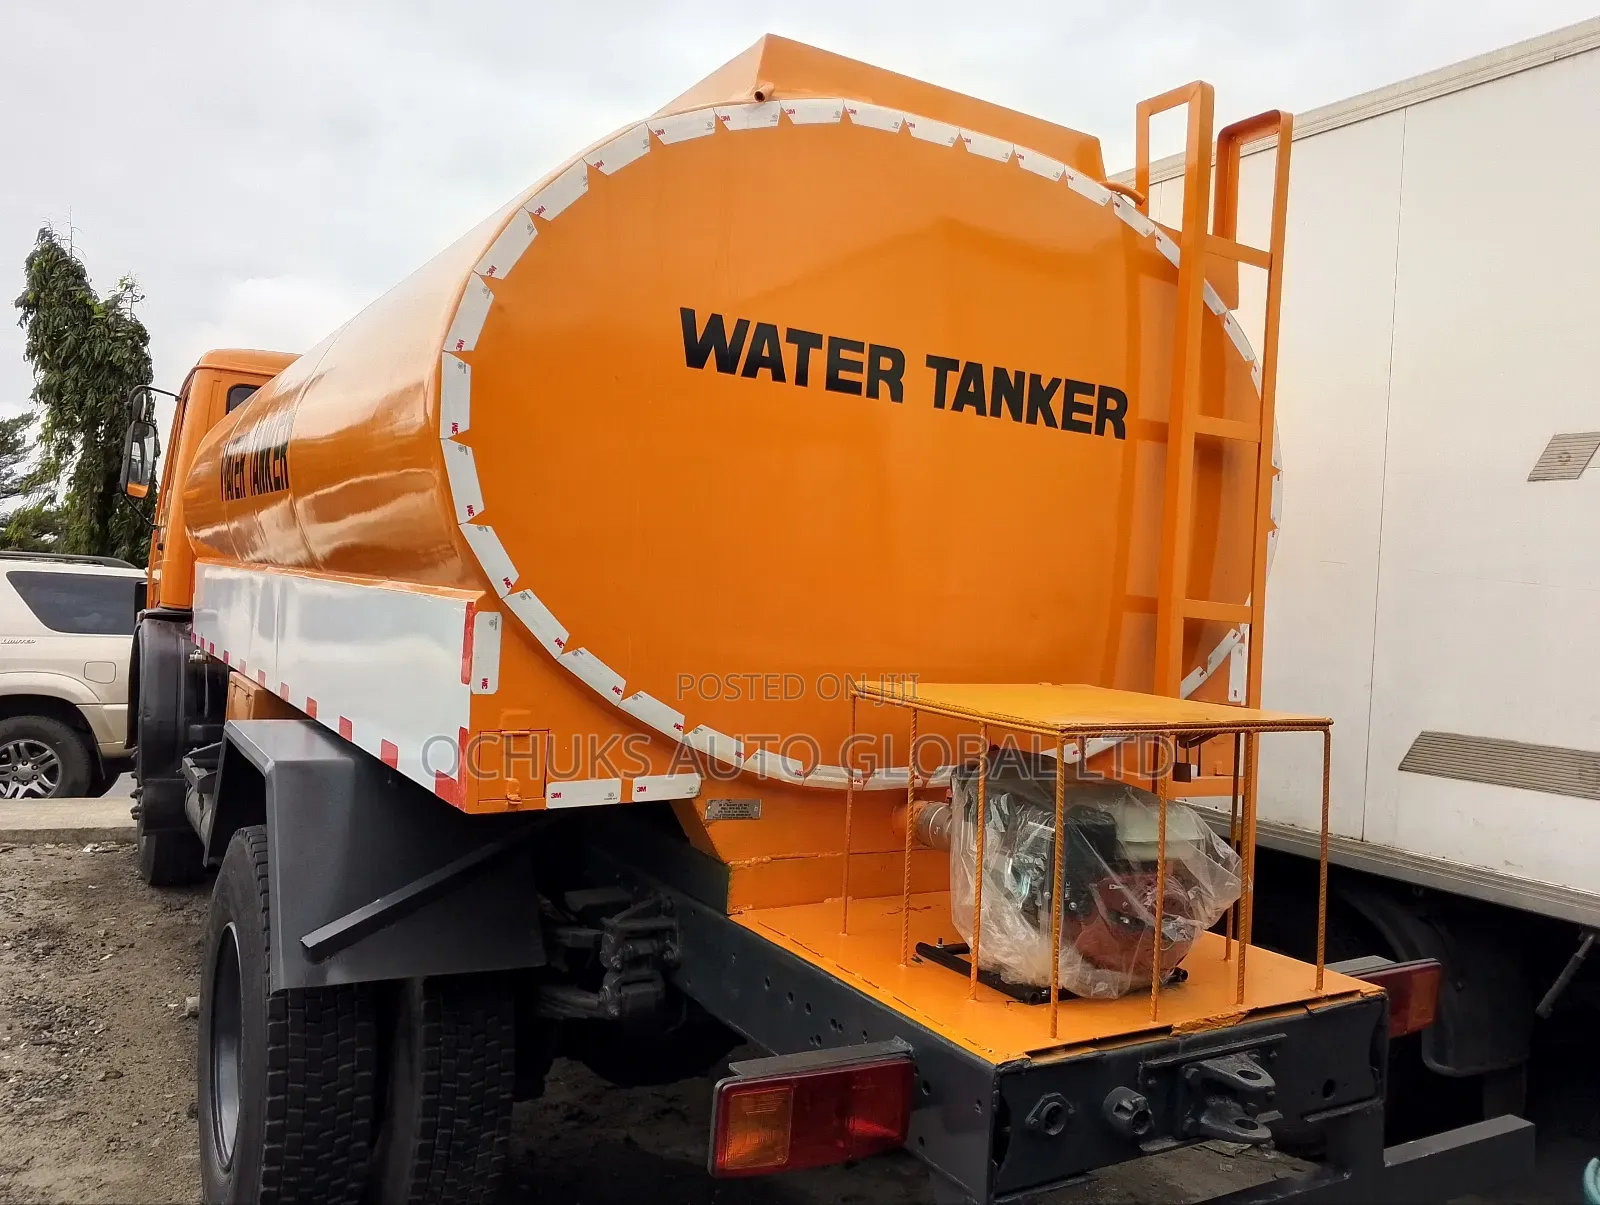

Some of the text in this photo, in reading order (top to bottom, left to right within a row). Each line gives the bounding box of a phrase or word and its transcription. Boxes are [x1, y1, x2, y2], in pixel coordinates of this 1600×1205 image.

[594, 160, 604, 169] 3M
[535, 205, 545, 215] 3M
[485, 265, 496, 276] 3M
[456, 339, 464, 351] 3M
[679, 307, 1128, 440] WATER TANKER
[452, 422, 458, 434] 3M
[466, 505, 474, 516] 3M
[503, 577, 513, 588] 3M
[554, 637, 564, 648] 3M
[482, 678, 488, 689] 3M
[612, 685, 622, 695] 3M
[673, 722, 683, 731] 3M
